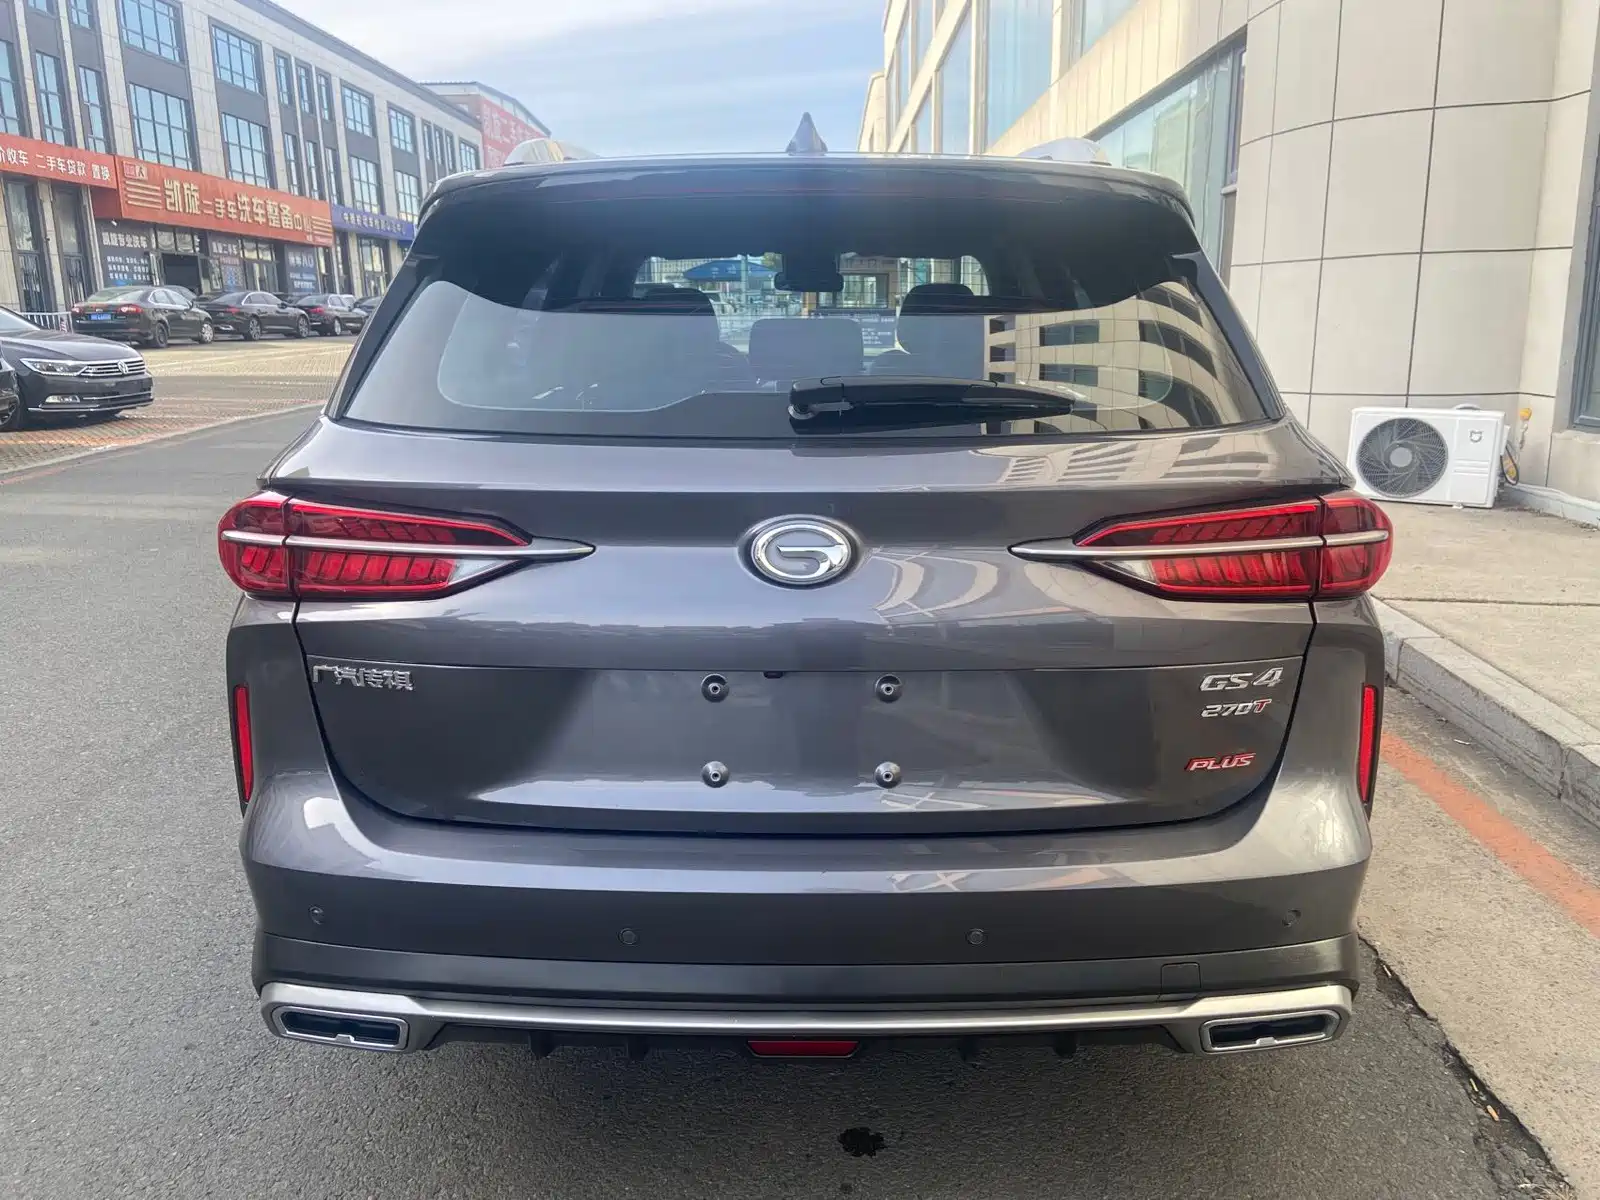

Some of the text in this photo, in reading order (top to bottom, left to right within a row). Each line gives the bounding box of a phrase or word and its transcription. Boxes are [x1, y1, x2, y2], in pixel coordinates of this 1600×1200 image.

[35, 153, 87, 177] 二手车贷款
[91, 163, 111, 181] 置换
[313, 664, 413, 691] 广汽传祺
[1200, 667, 1284, 691] GS4
[1201, 698, 1272, 718] 270T
[1184, 752, 1256, 771] PLUS
